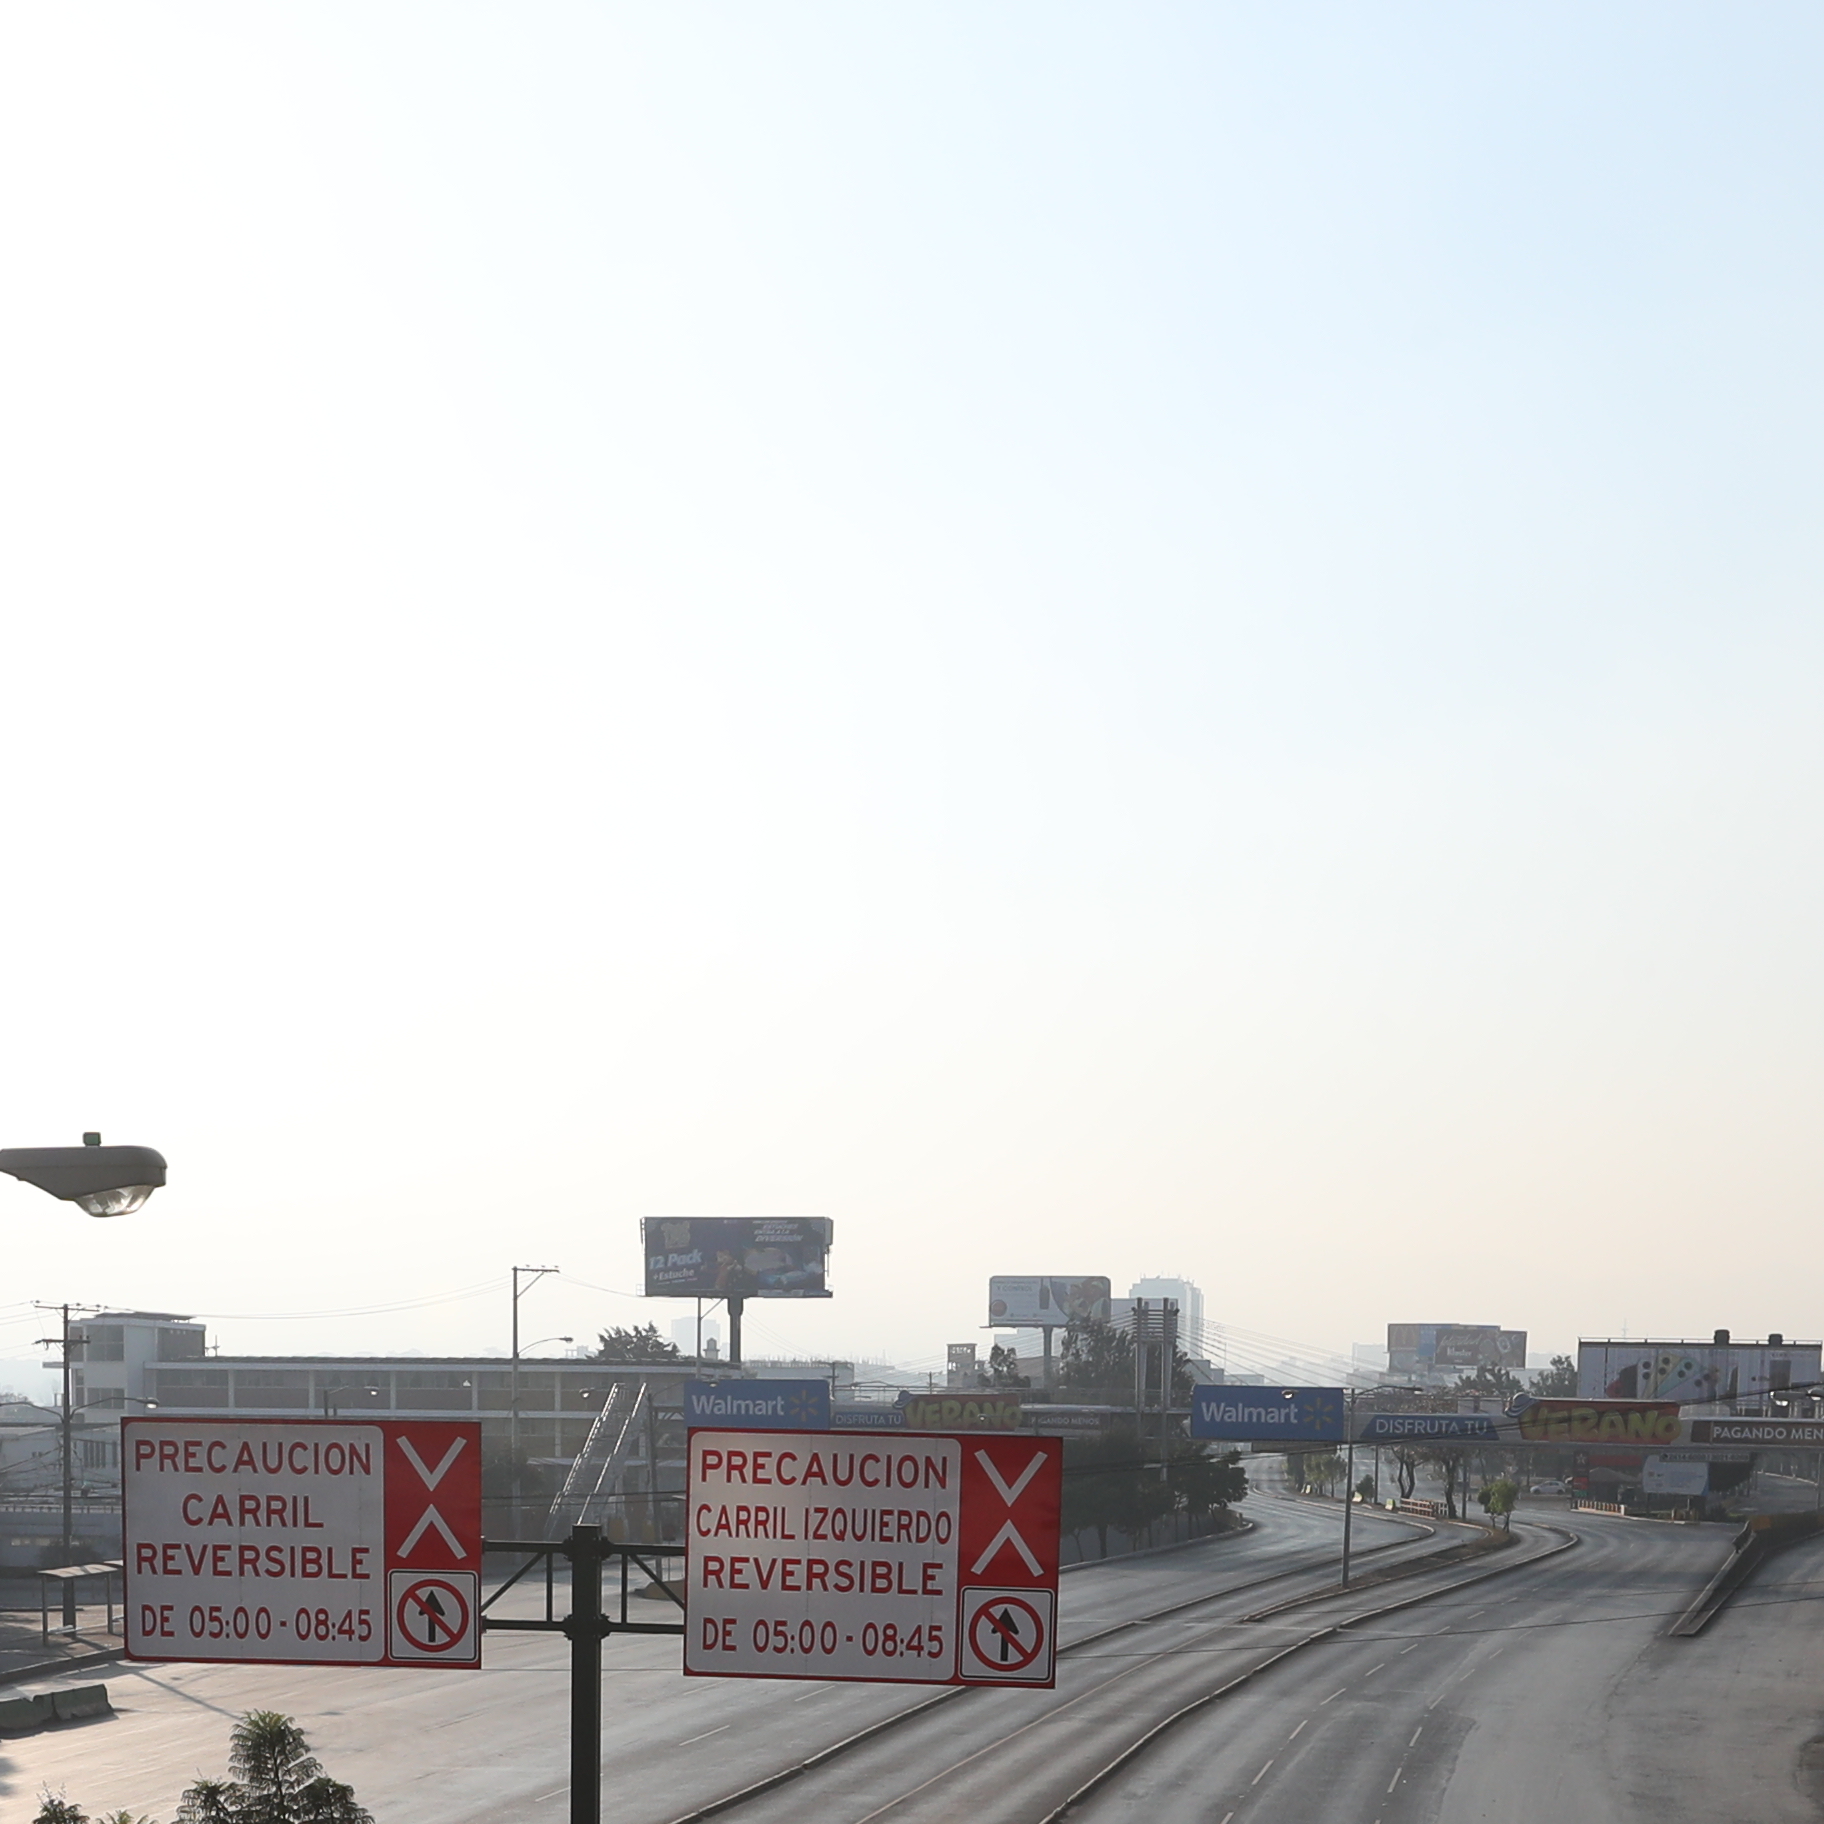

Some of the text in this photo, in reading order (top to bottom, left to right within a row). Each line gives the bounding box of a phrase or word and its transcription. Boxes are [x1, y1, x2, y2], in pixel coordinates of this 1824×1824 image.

[667, 1249, 703, 1267] Pack
[692, 1395, 785, 1416] Walmart
[836, 1413, 901, 1425] DISFRUTA TU
[903, 1400, 1023, 1430] VERANO
[1201, 1402, 1298, 1423] Walmart
[1376, 1420, 1487, 1435] DISFRUTA TU
[1518, 1406, 1682, 1443] VERANO
[1713, 1425, 1787, 1441] PAGANDO
[135, 1439, 371, 1476] PRECAUCION
[701, 1449, 947, 1489] PRECAUCION
[182, 1493, 324, 1528] CARRIL
[696, 1504, 951, 1545] CARRIL IZQUIERDO
[136, 1542, 371, 1579] REVERSIBLE
[702, 1555, 943, 1596] REVERSIBLE
[141, 1604, 174, 1637] DE
[702, 1617, 736, 1651] DE
